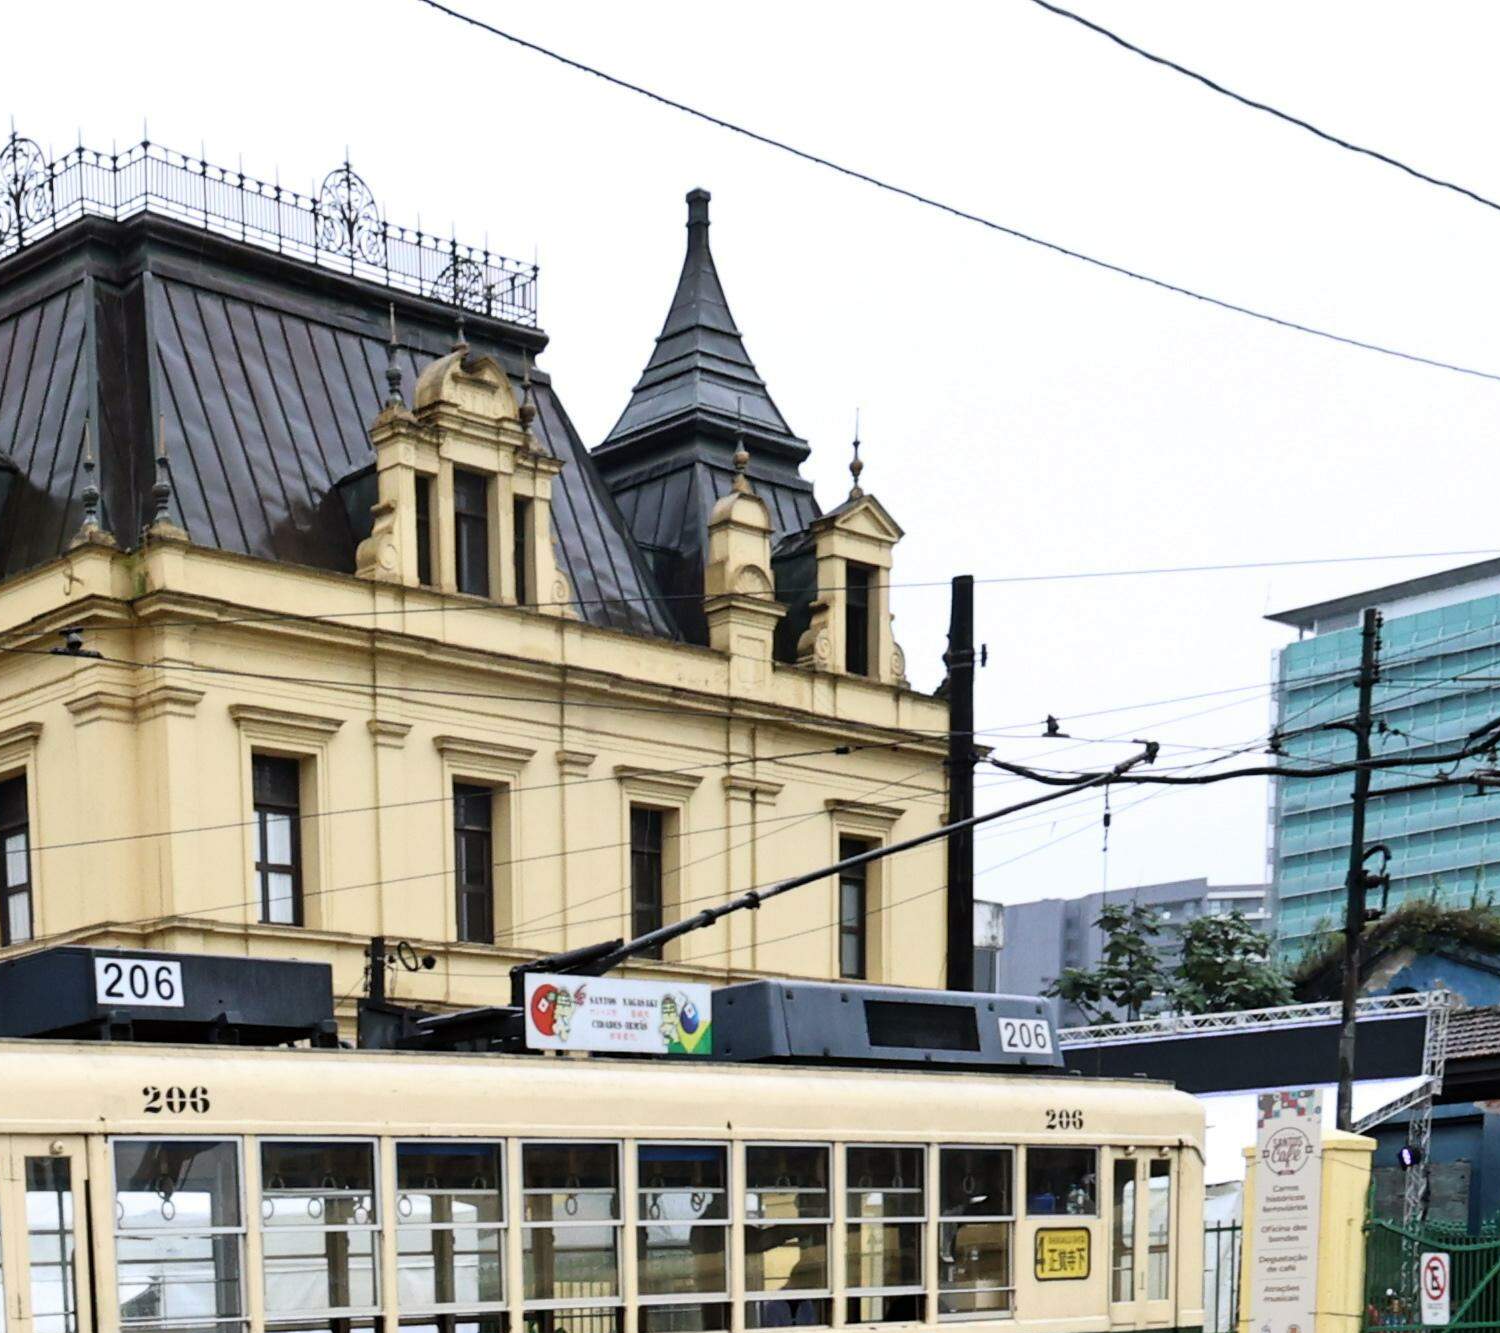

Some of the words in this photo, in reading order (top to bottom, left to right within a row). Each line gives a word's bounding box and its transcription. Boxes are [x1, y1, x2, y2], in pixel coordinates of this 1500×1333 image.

[104, 963, 174, 1000] 206
[1005, 1022, 1046, 1048] 206
[142, 1086, 210, 1114] 206
[1045, 1109, 1084, 1130] 206
